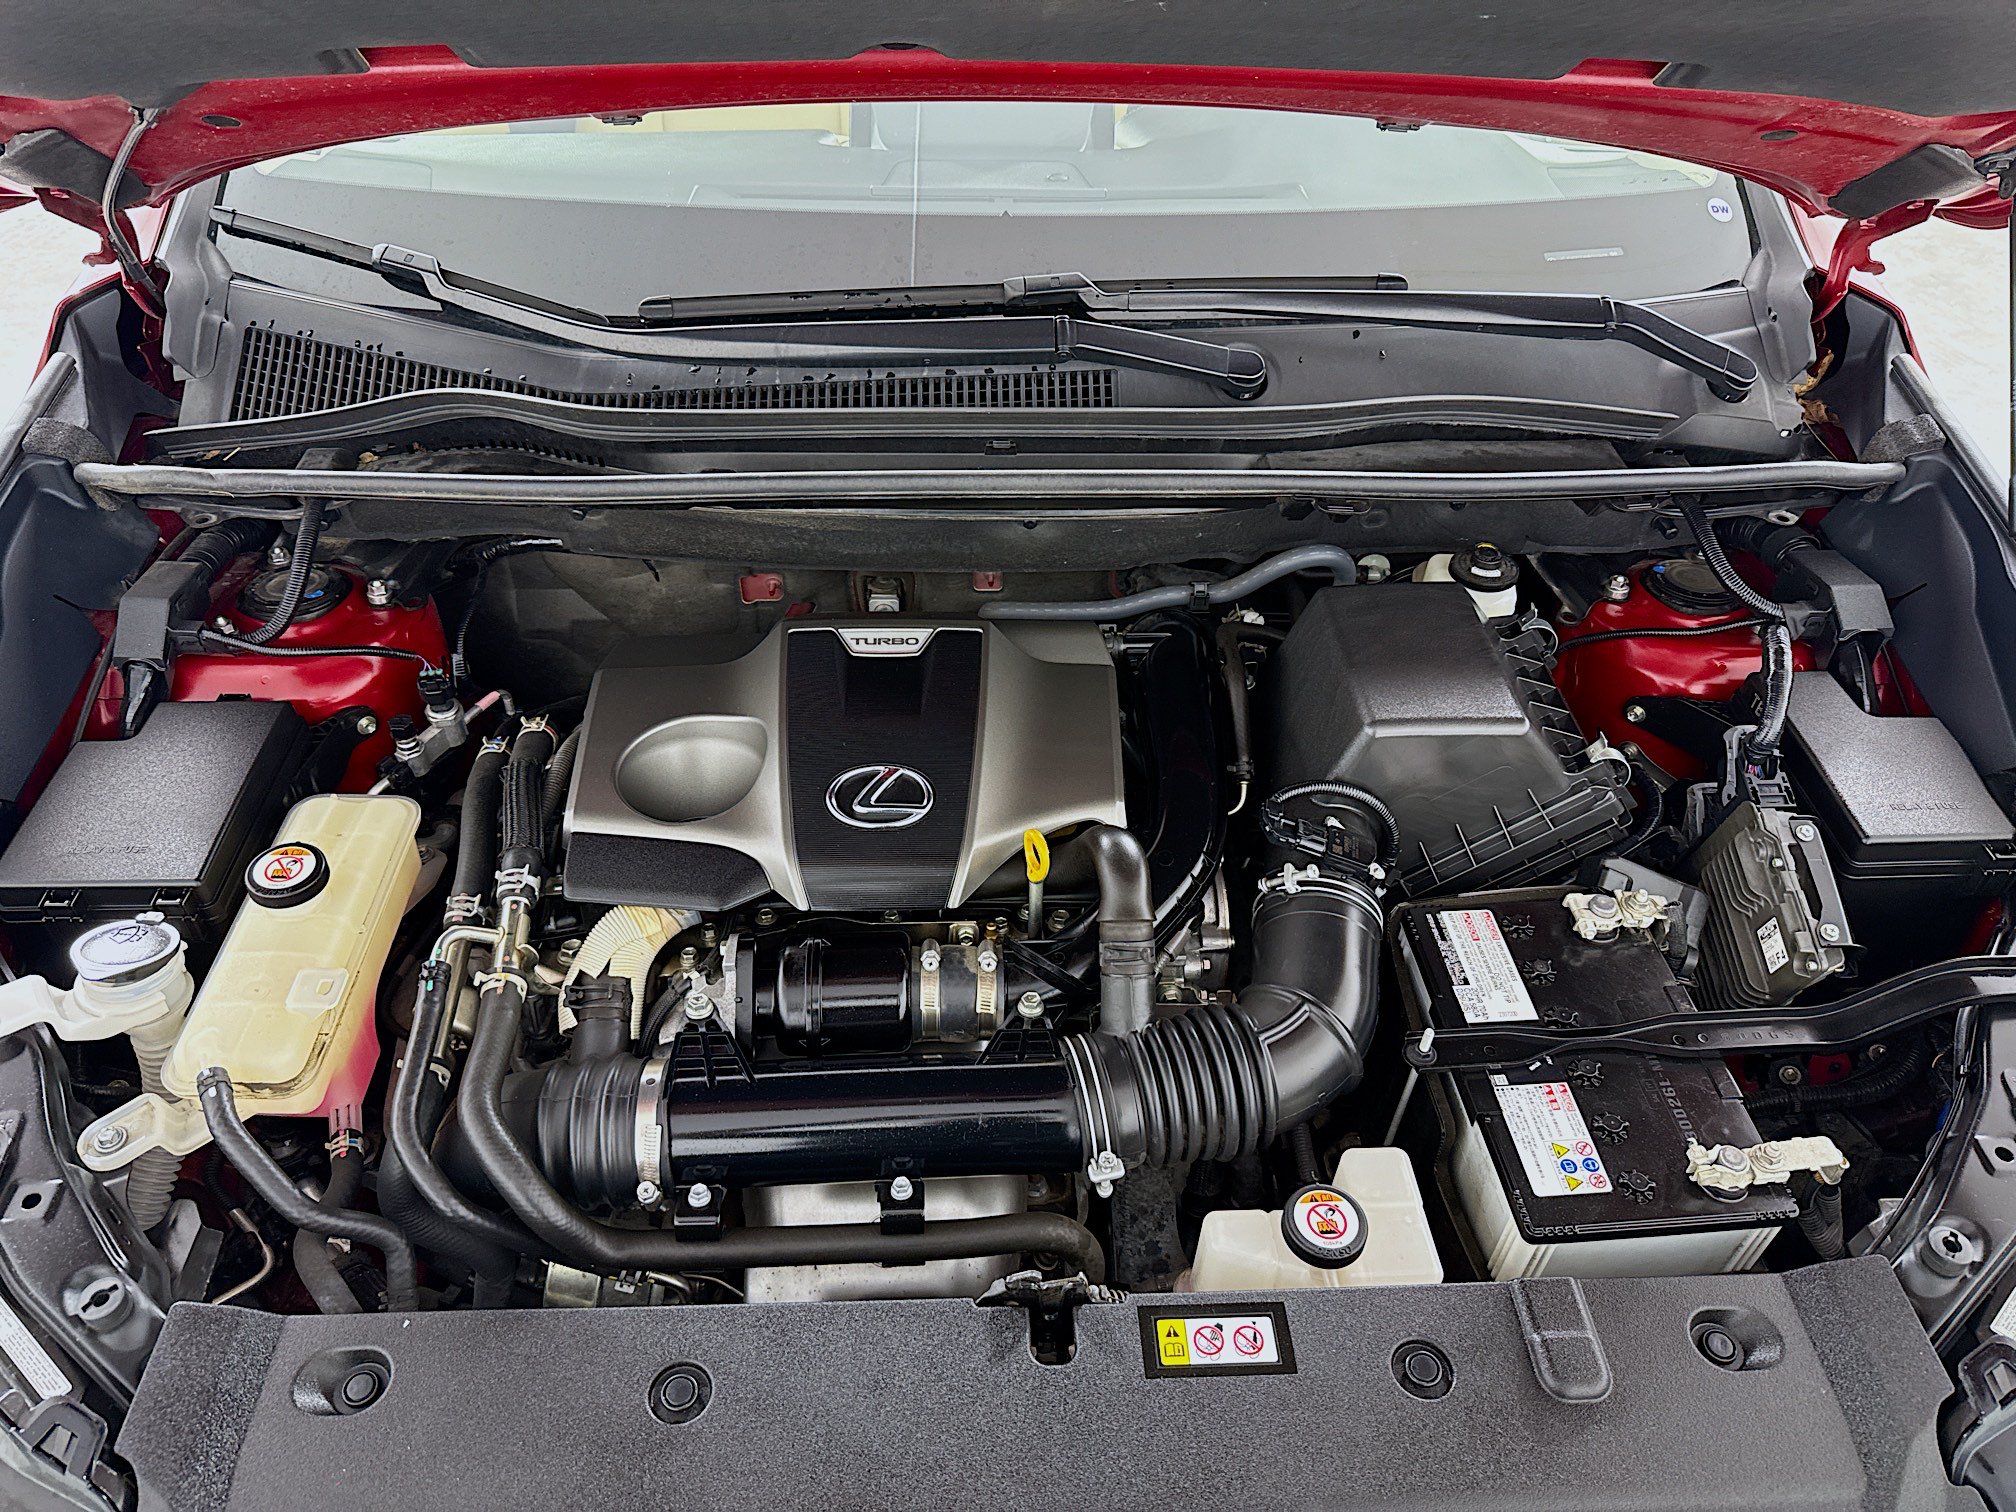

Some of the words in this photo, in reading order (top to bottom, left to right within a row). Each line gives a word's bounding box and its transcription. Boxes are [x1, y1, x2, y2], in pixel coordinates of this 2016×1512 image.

[1711, 205, 1729, 213] DW
[850, 637, 919, 645] TURBO
[1315, 1245, 1352, 1258] DENSO
